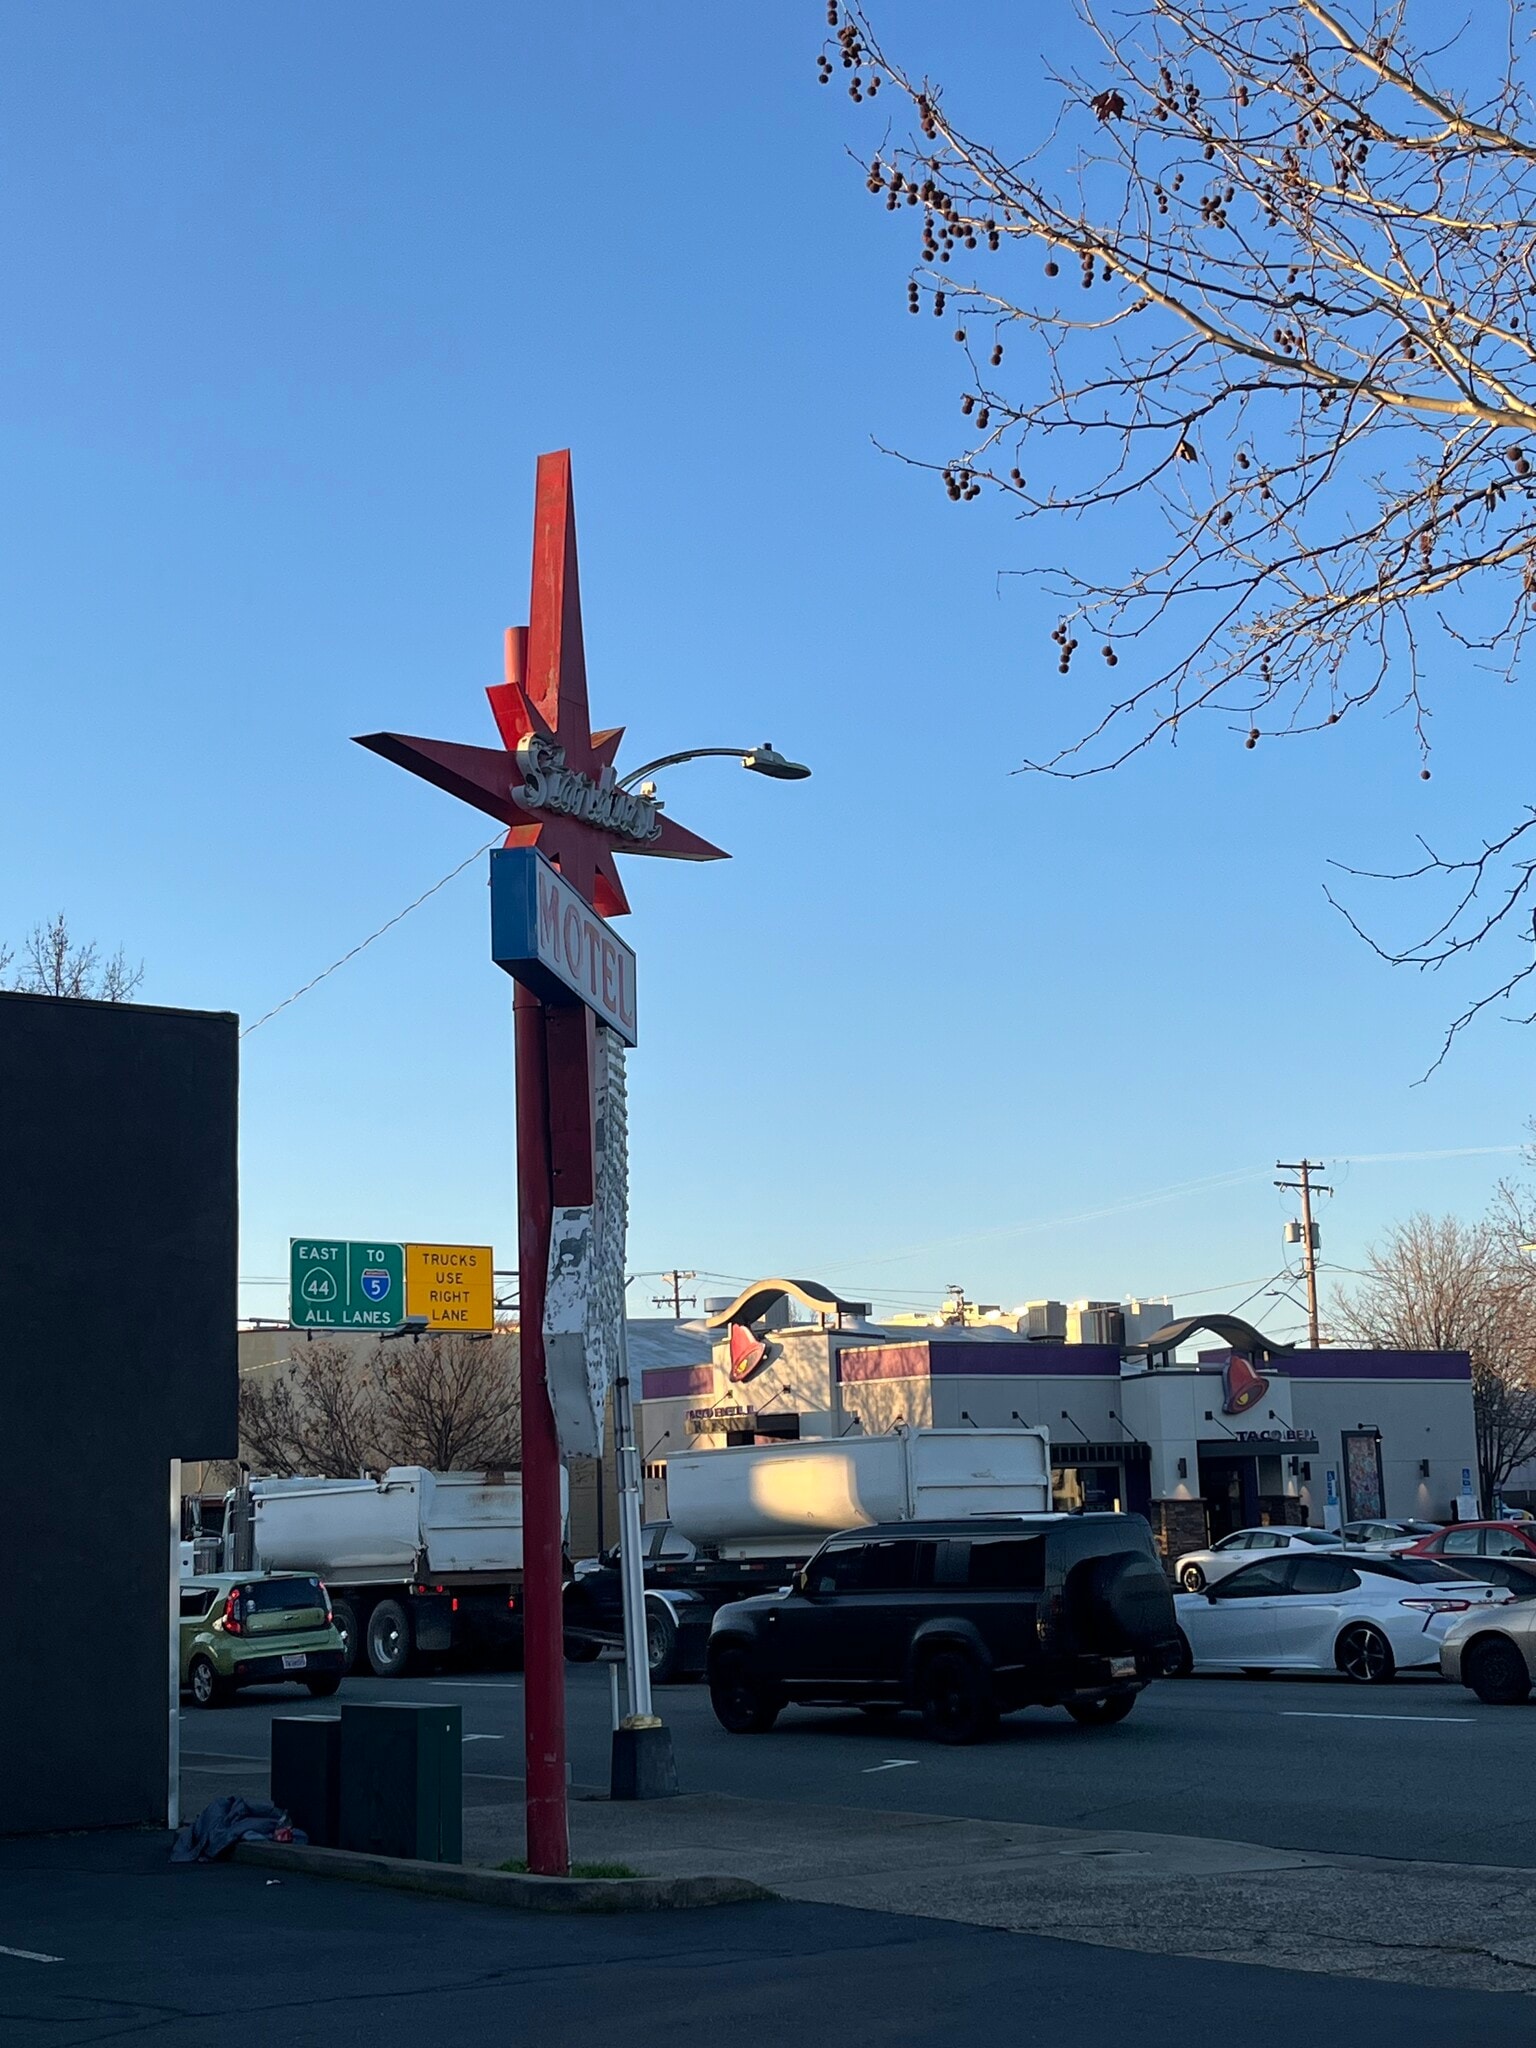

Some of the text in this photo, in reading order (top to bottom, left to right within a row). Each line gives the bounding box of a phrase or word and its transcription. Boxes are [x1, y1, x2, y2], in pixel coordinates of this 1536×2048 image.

[538, 871, 634, 1029] MOTEL
[299, 1246, 338, 1261] EAST
[366, 1249, 385, 1262] TO
[422, 1253, 477, 1266] TRUCKS
[435, 1272, 463, 1284] USE
[307, 1280, 330, 1296] 44
[371, 1280, 381, 1296] 5
[430, 1290, 470, 1303] RIGHT
[305, 1309, 391, 1324] ALL LANES
[432, 1309, 468, 1321] LANE
[1235, 1429, 1317, 1442] TACO BELL
